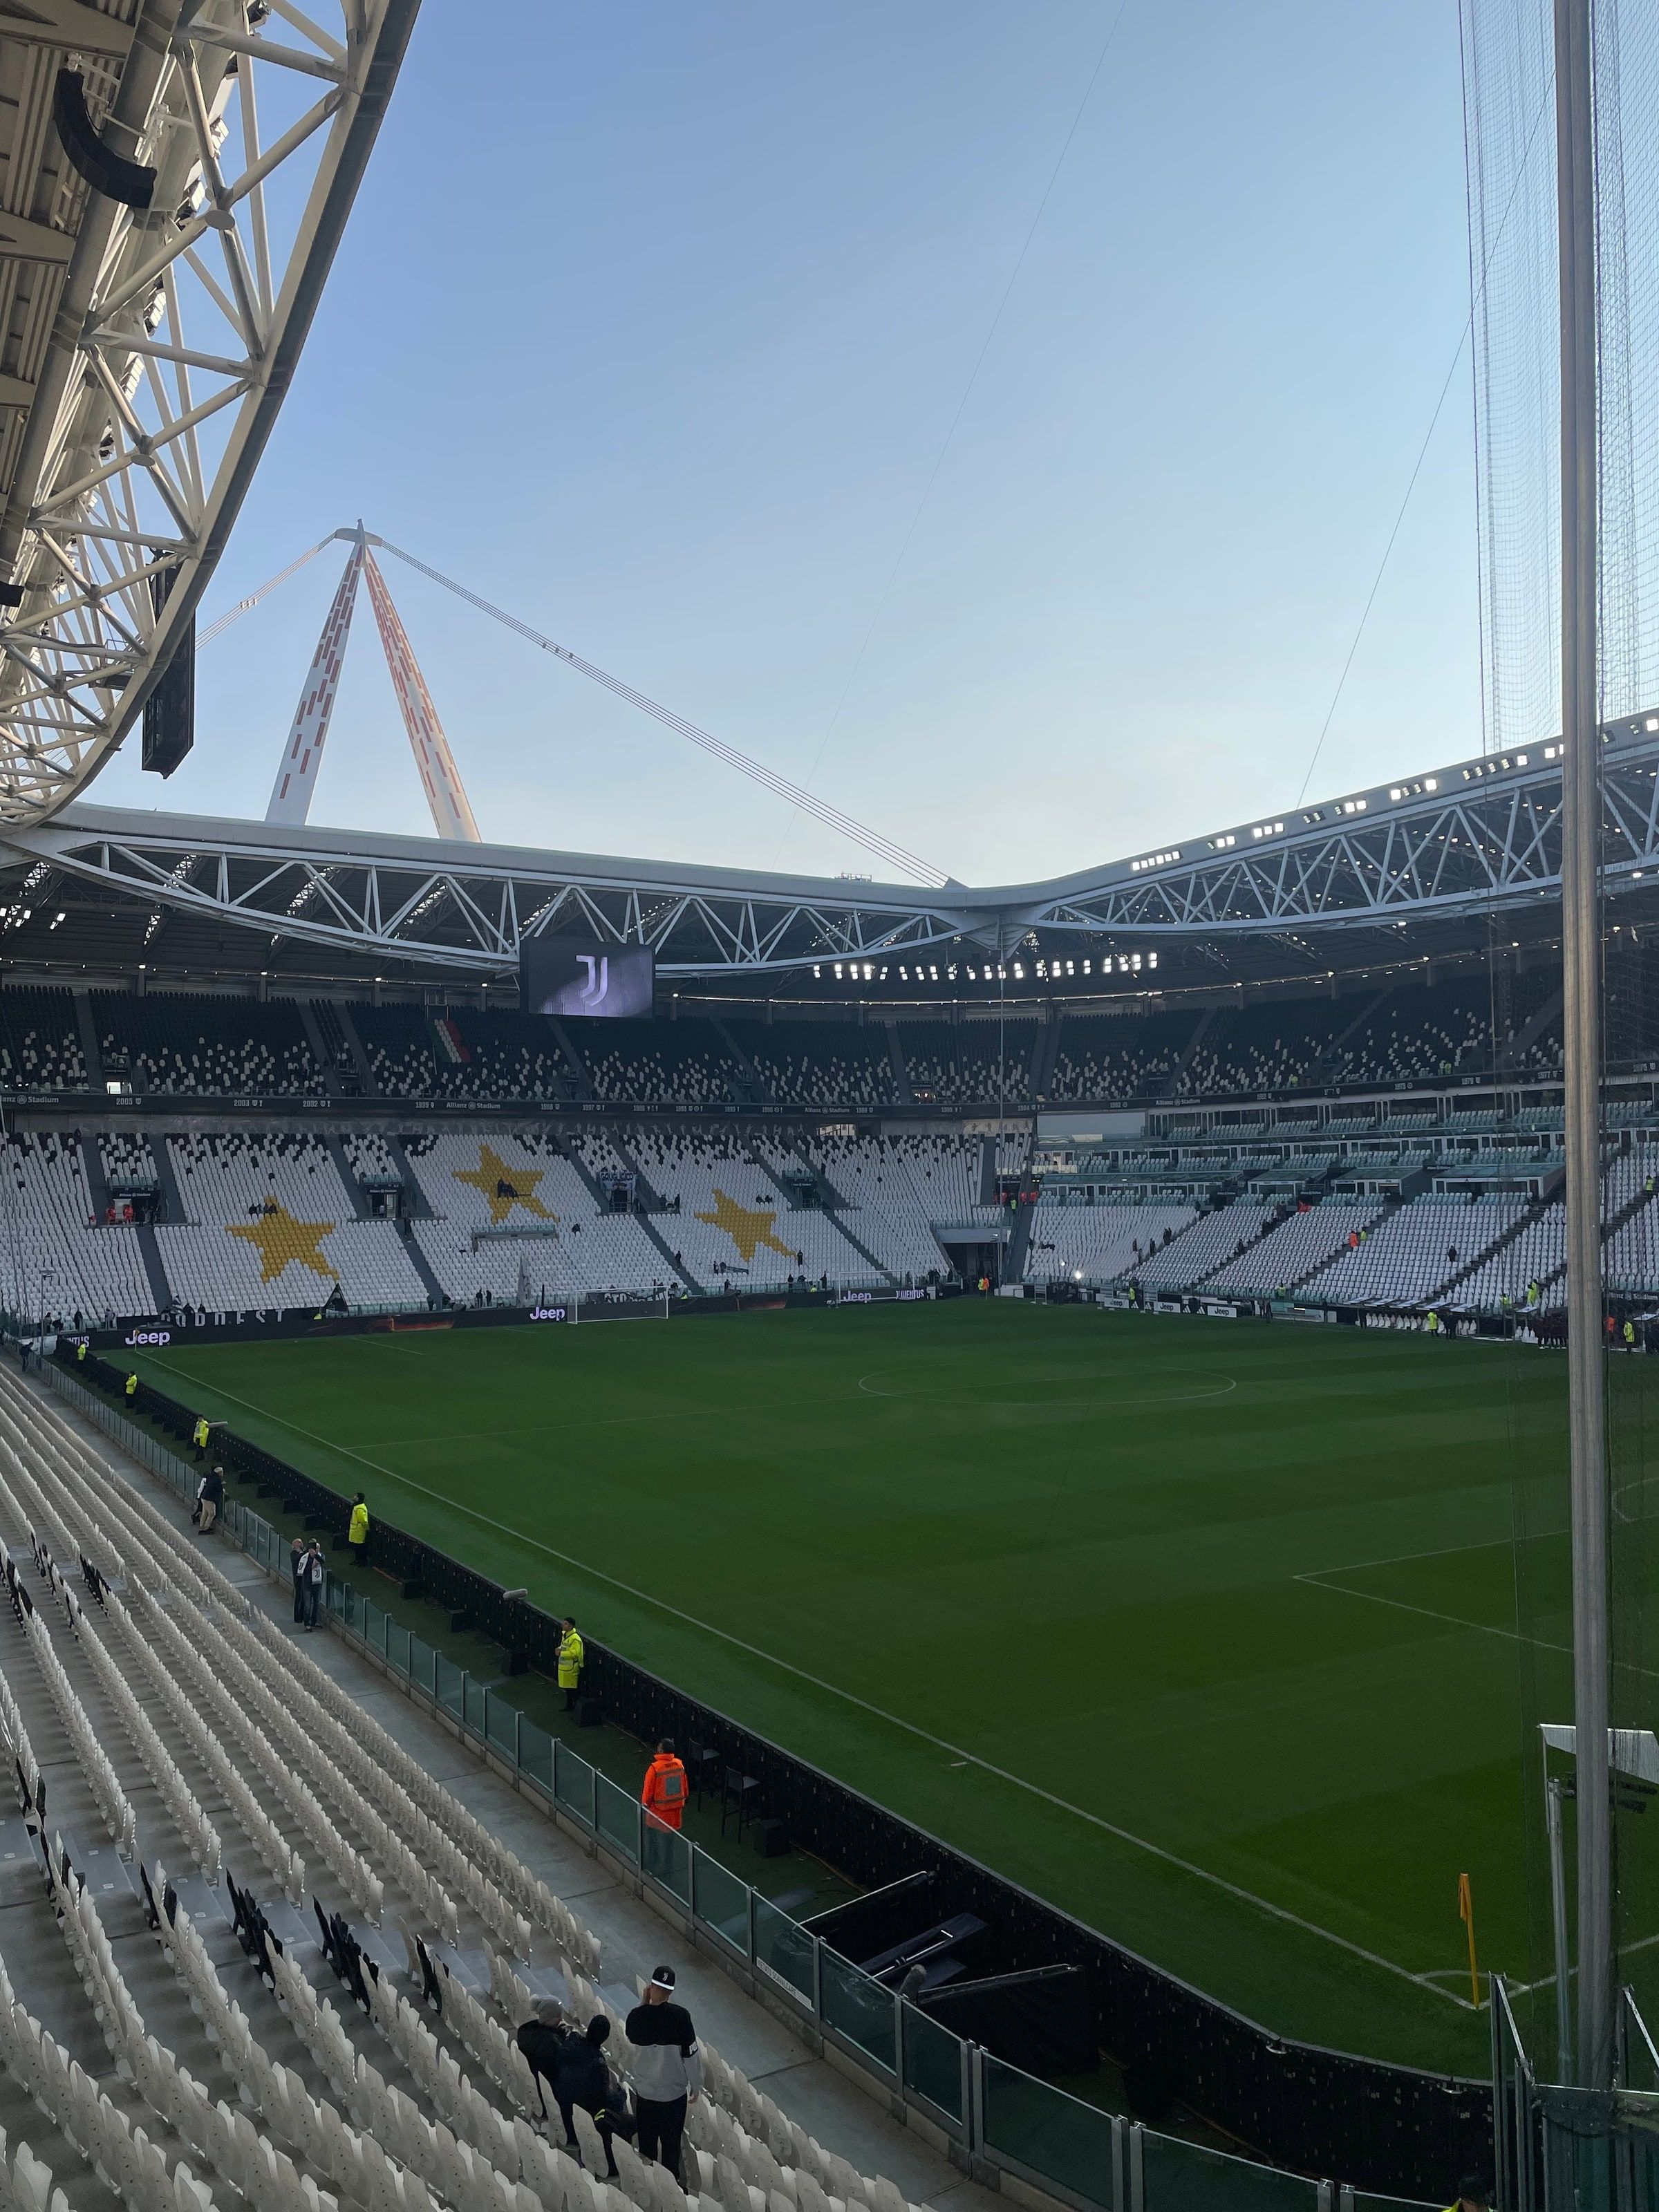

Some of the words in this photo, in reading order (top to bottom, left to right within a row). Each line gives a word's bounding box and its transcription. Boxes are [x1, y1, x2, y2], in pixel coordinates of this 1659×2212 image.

[843, 1290, 872, 1304] Jeep
[895, 1289, 924, 1300] JUVENTUS
[1109, 1298, 1123, 1306] Jeep
[1160, 1303, 1174, 1311] Jeep
[529, 1306, 565, 1322] Jeep
[1215, 1306, 1230, 1316] Jeep
[124, 1331, 171, 1346] Jeep
